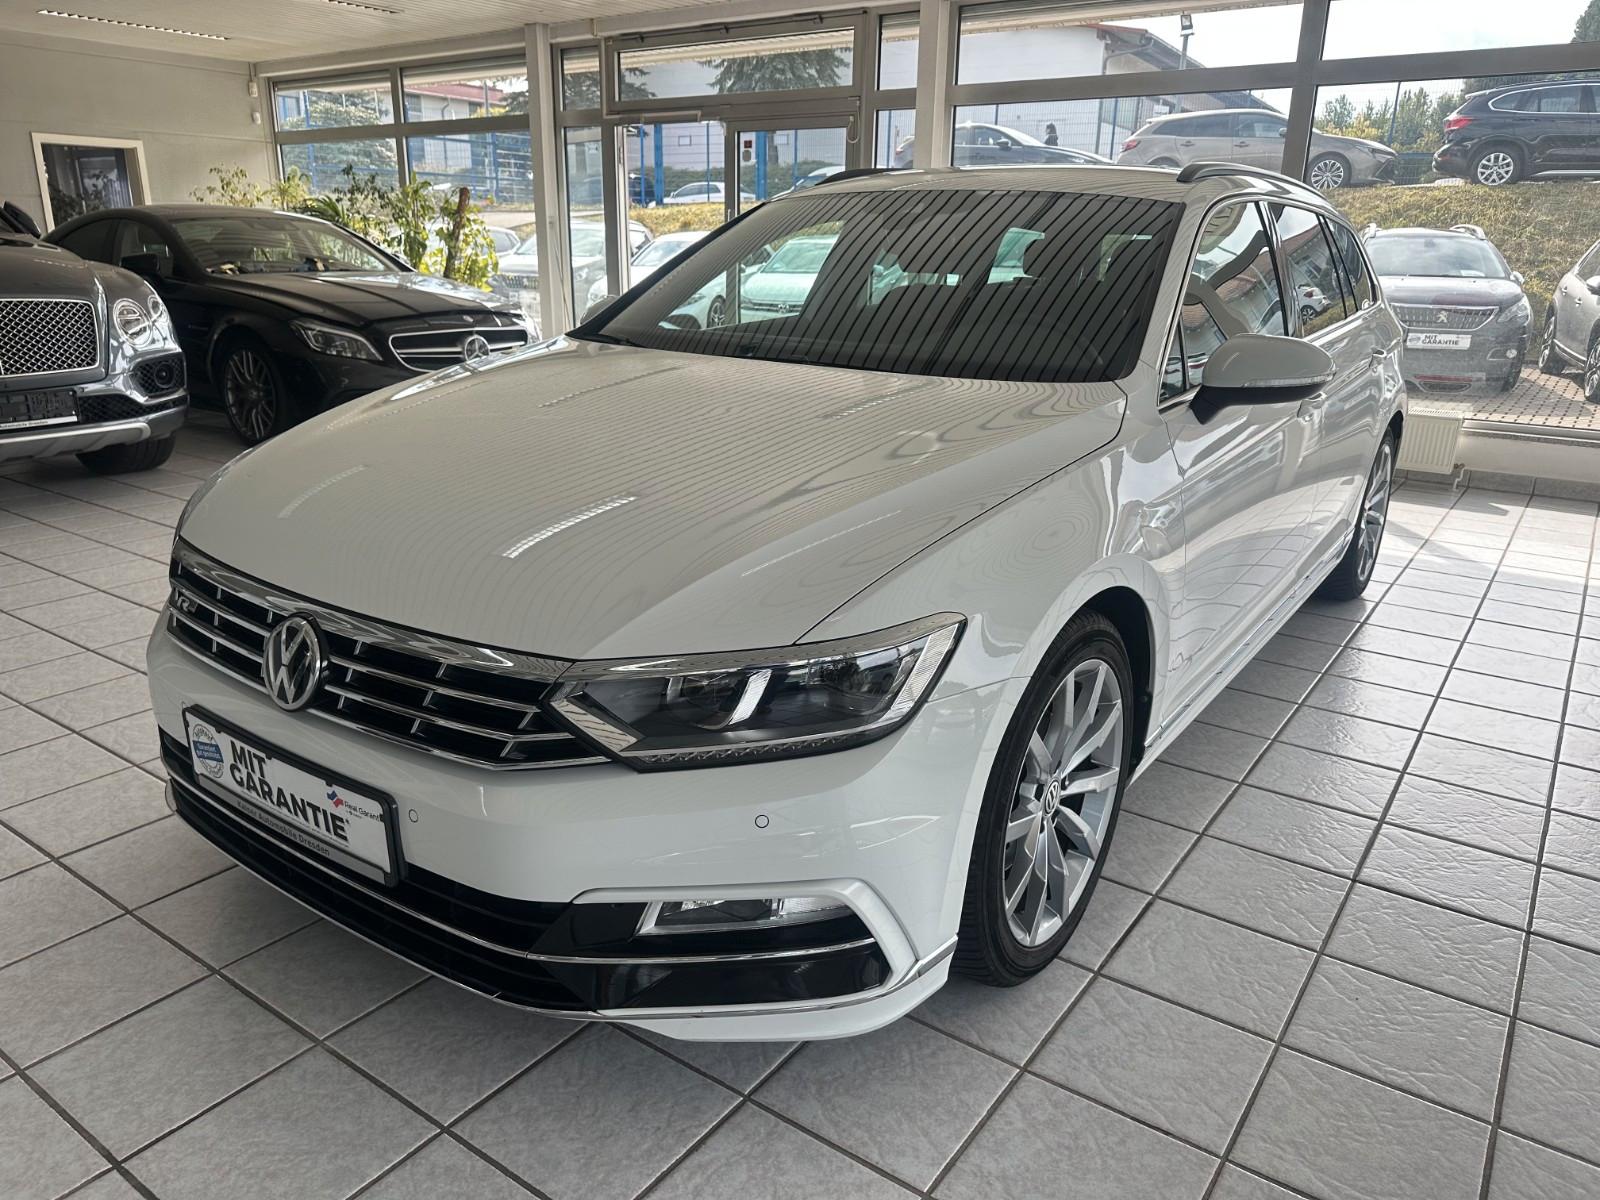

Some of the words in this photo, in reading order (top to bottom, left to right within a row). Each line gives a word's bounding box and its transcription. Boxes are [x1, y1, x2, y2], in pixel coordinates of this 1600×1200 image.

[230, 739, 266, 779] MIT
[344, 800, 358, 812] Real
[358, 807, 380, 822] Garant
[258, 811, 297, 840] Automobile
[298, 833, 330, 857] Dresden
